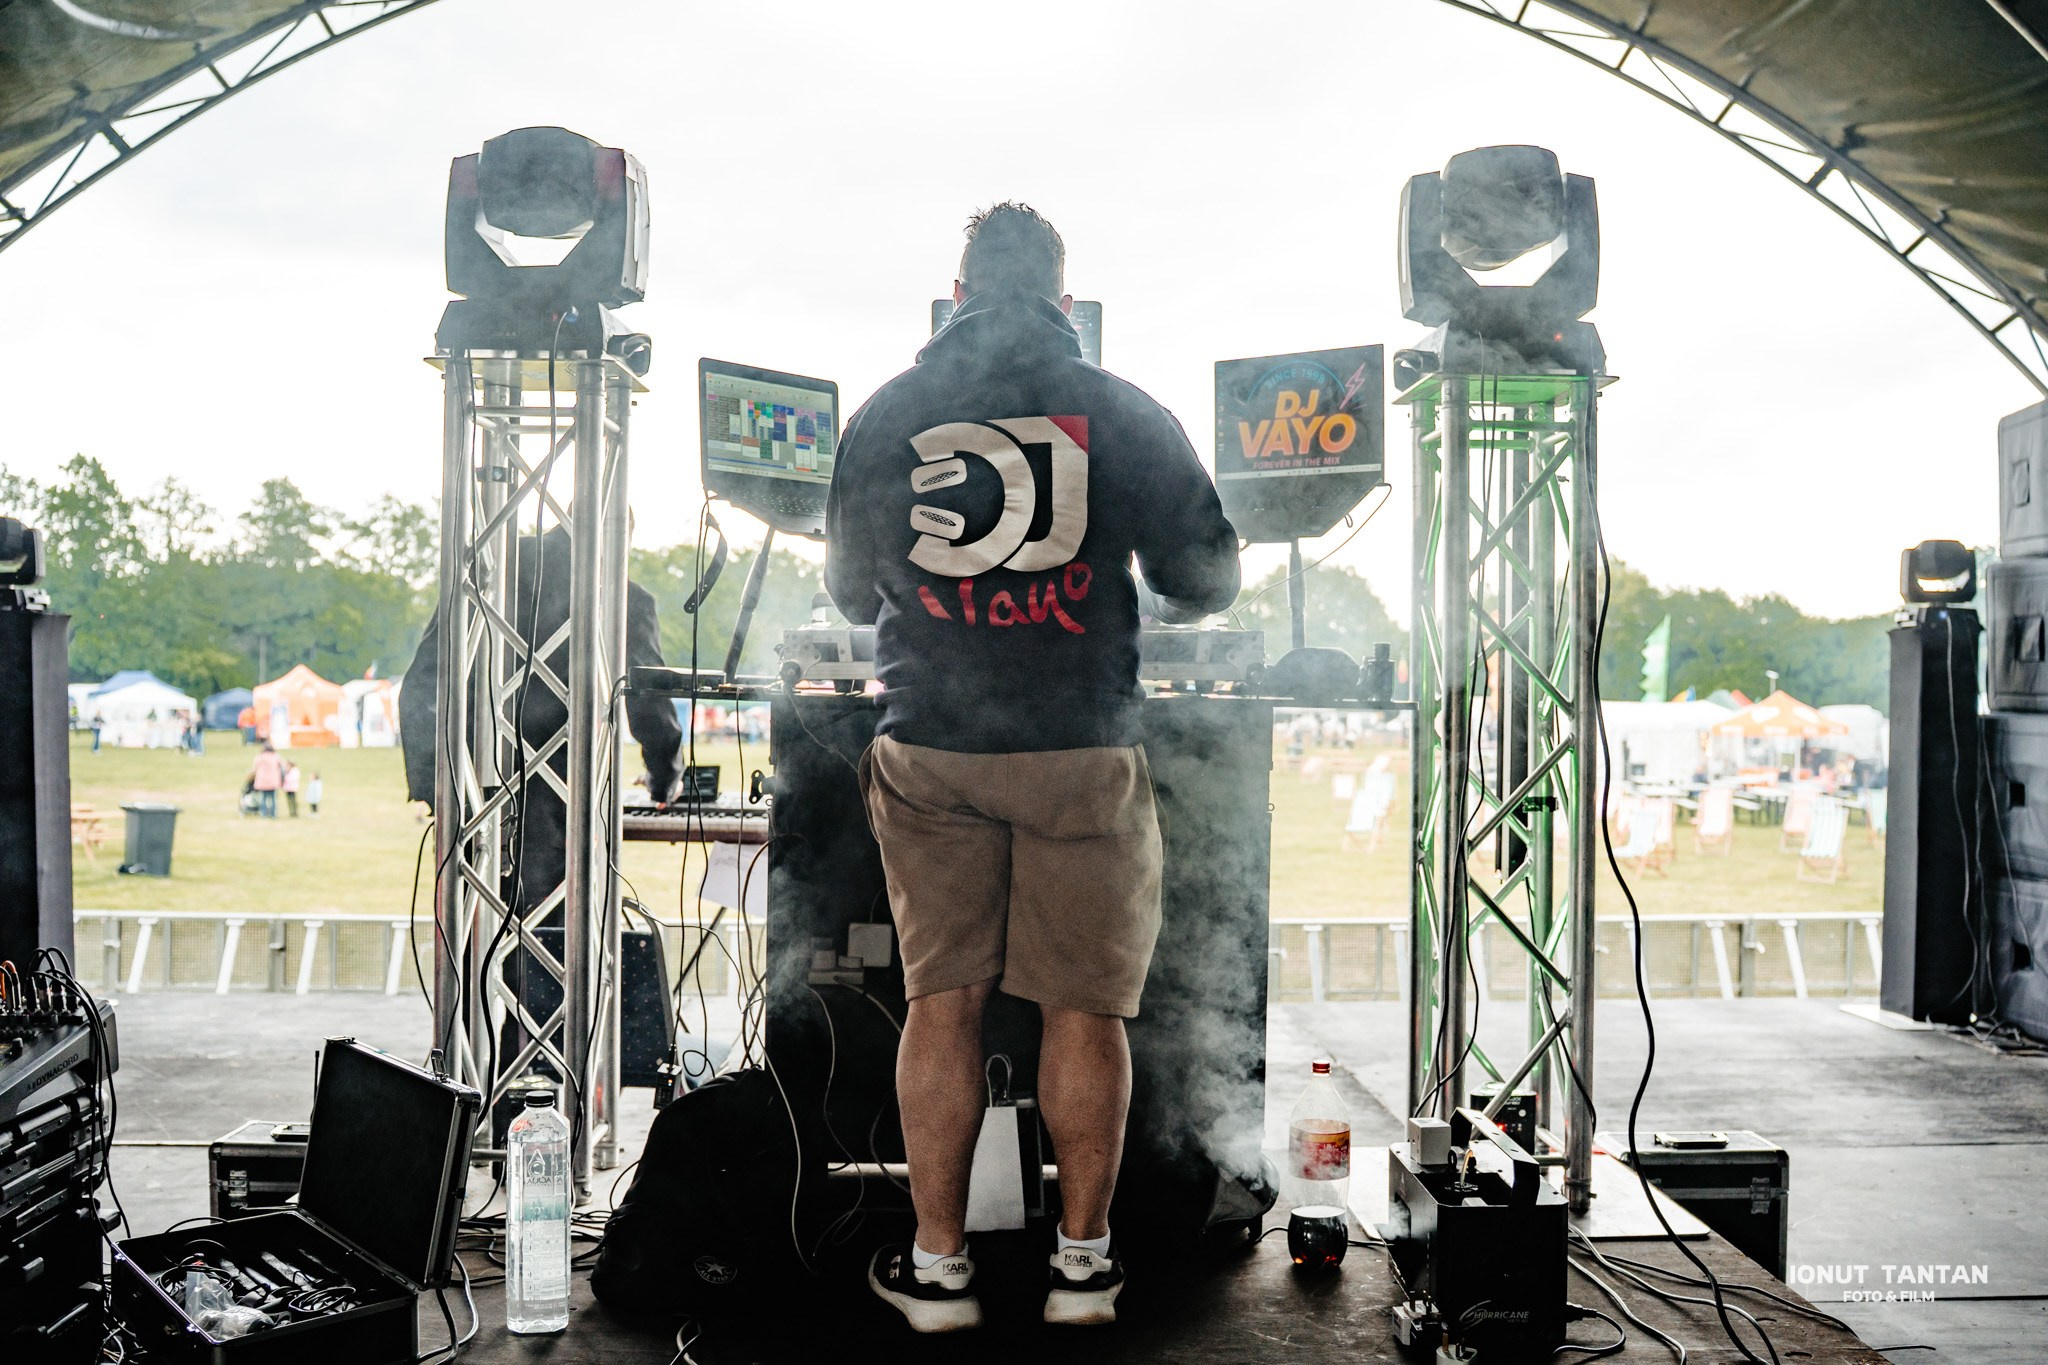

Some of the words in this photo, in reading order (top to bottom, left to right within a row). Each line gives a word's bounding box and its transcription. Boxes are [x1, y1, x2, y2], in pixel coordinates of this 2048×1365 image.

[1264, 368, 1297, 389] SINCE
[1302, 368, 1326, 384] 1998
[1275, 389, 1320, 418] DJ
[1238, 413, 1357, 458] VAYO
[1253, 459, 1291, 470] FOREVER
[1293, 459, 1302, 468] IN
[1305, 457, 1321, 467] THE
[1323, 456, 1341, 466] MIX
[36, 1053, 79, 1086] DYNACORD
[943, 1263, 968, 1272] KARL
[1065, 1254, 1092, 1264] KARL
[1474, 1311, 1530, 1319] HURRICANE
